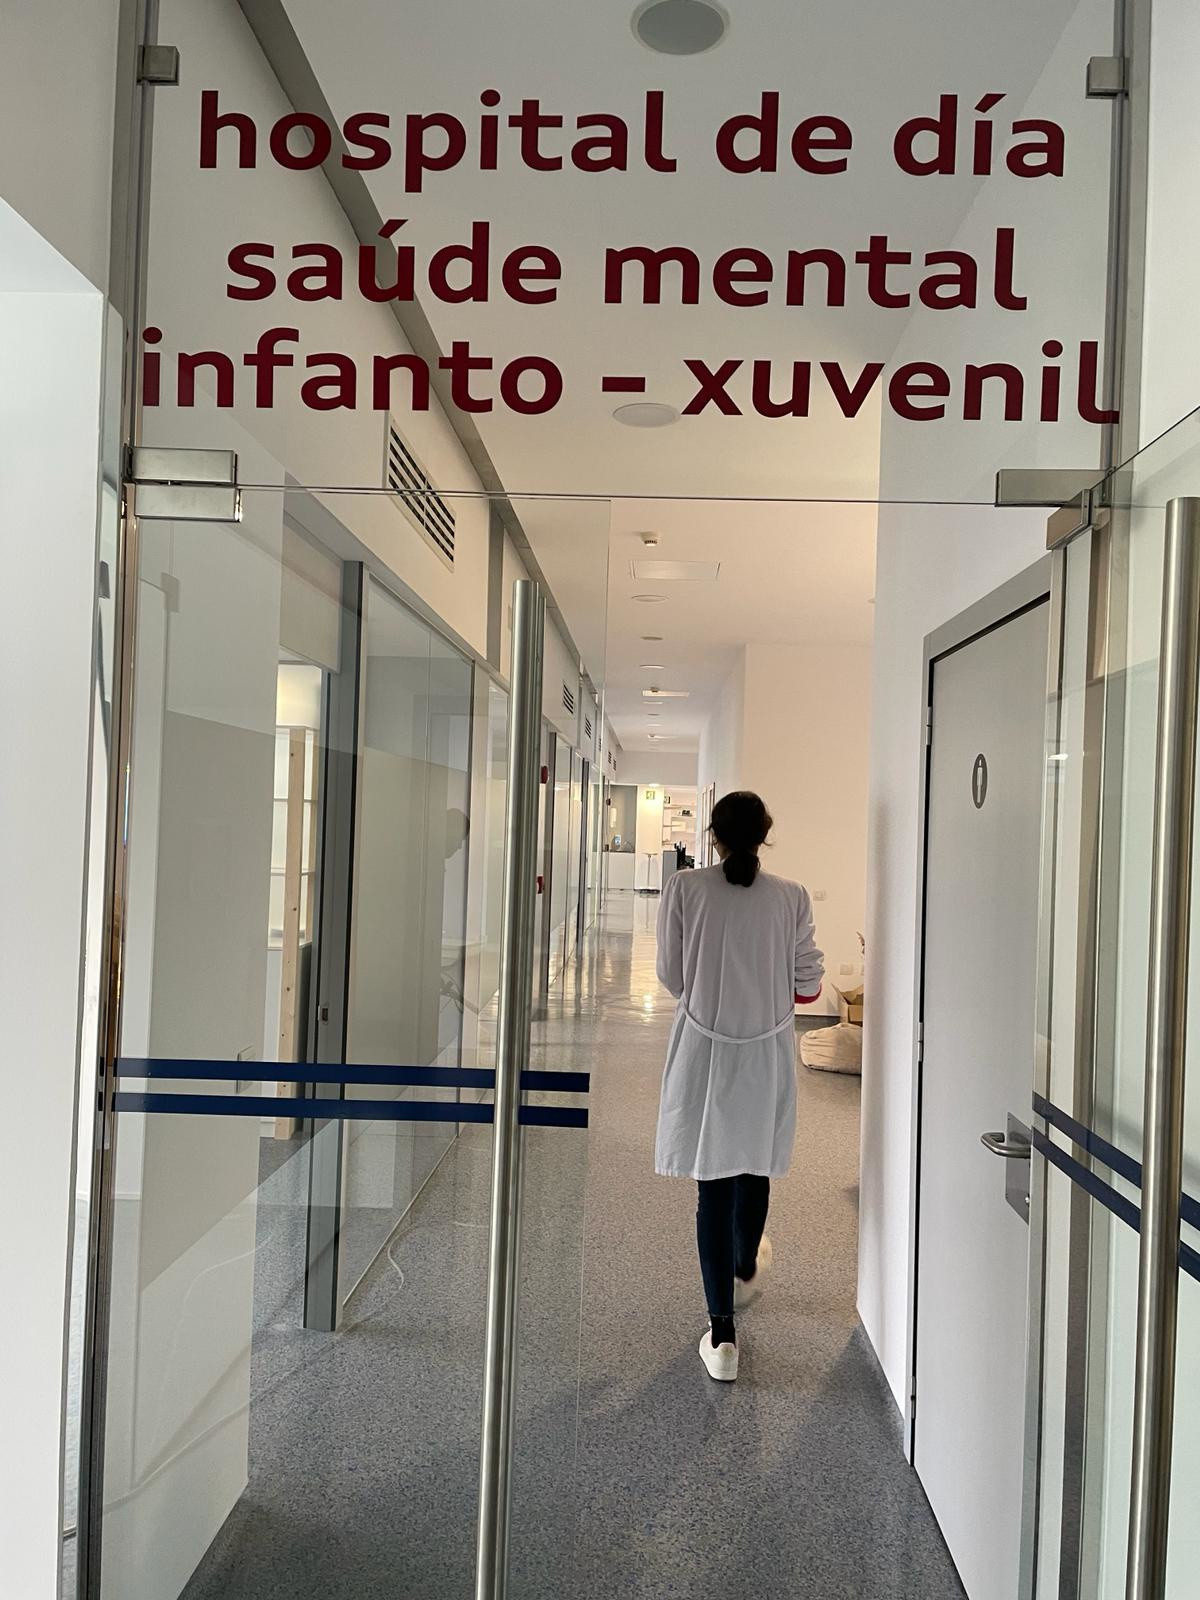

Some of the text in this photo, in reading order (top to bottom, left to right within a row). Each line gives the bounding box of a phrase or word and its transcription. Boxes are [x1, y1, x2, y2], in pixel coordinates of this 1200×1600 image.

[200, 89, 1063, 193] hospital de día
[227, 219, 1026, 310] saúde mental
[143, 326, 563, 415] infanto
[680, 338, 1119, 425] xuvenil
